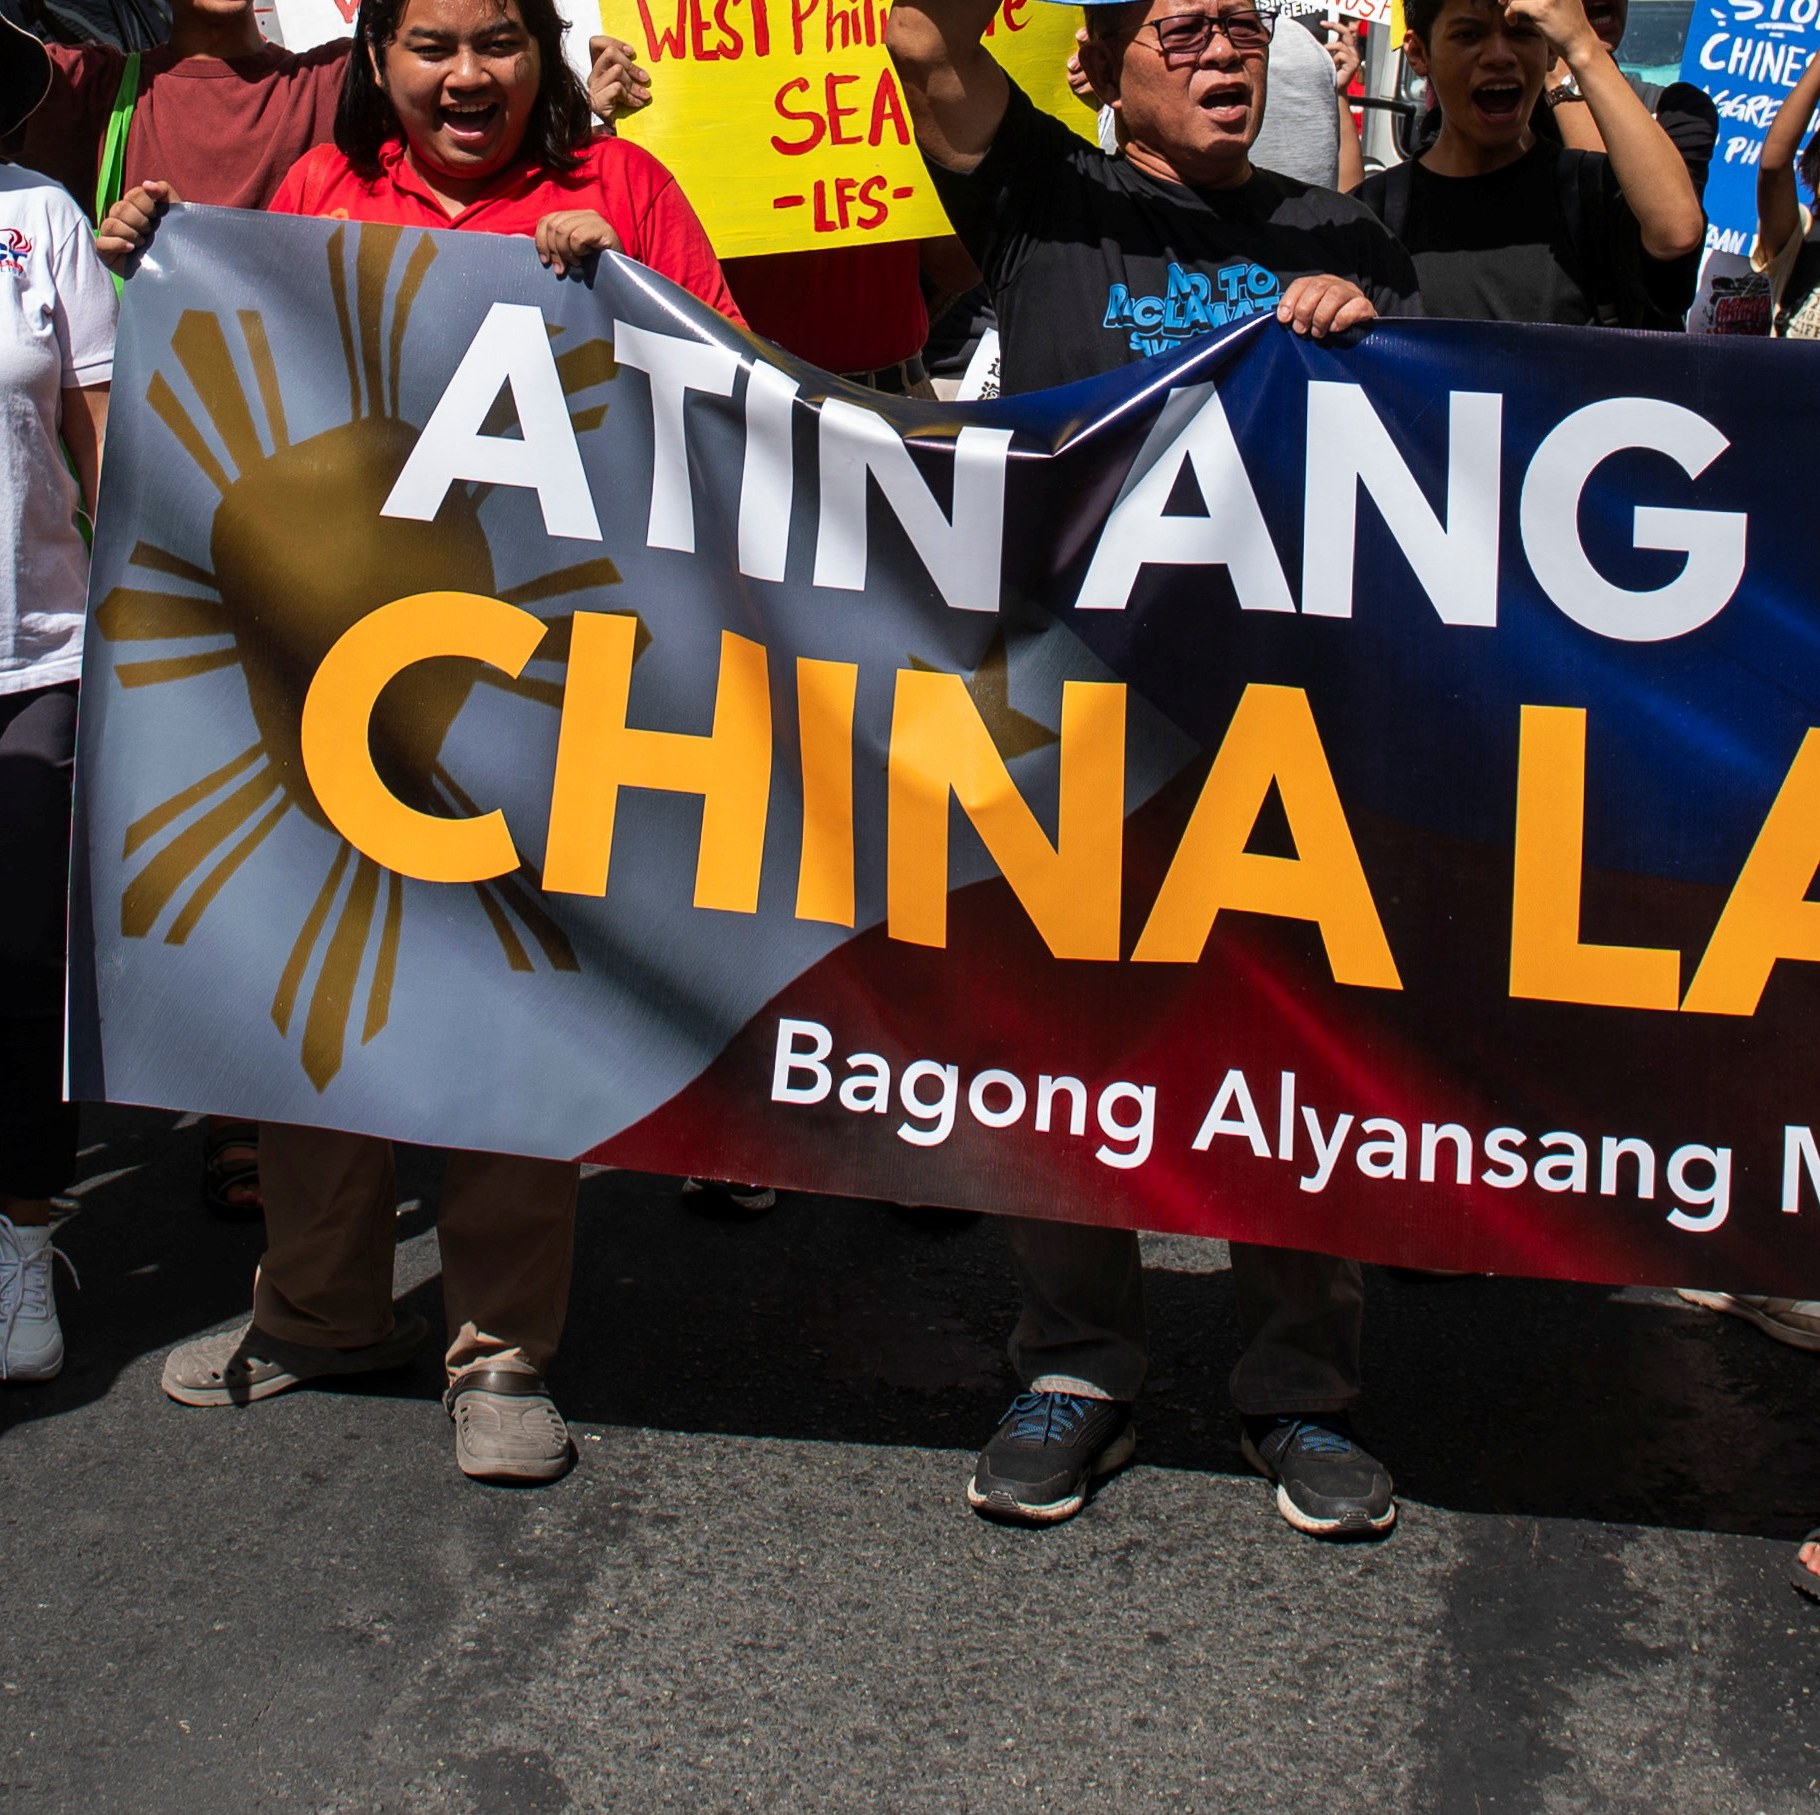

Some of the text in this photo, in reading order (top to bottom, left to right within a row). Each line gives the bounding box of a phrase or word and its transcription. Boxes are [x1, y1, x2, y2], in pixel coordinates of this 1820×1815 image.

[771, 67, 912, 156] SEA
[1217, 263, 1281, 301] TO
[380, 302, 1013, 612] ATIN
[1076, 380, 1748, 643] ANG
[302, 590, 1406, 992] CHINA
[770, 1017, 1157, 1170] Bagong
[1191, 1068, 1733, 1234] Alyansang
